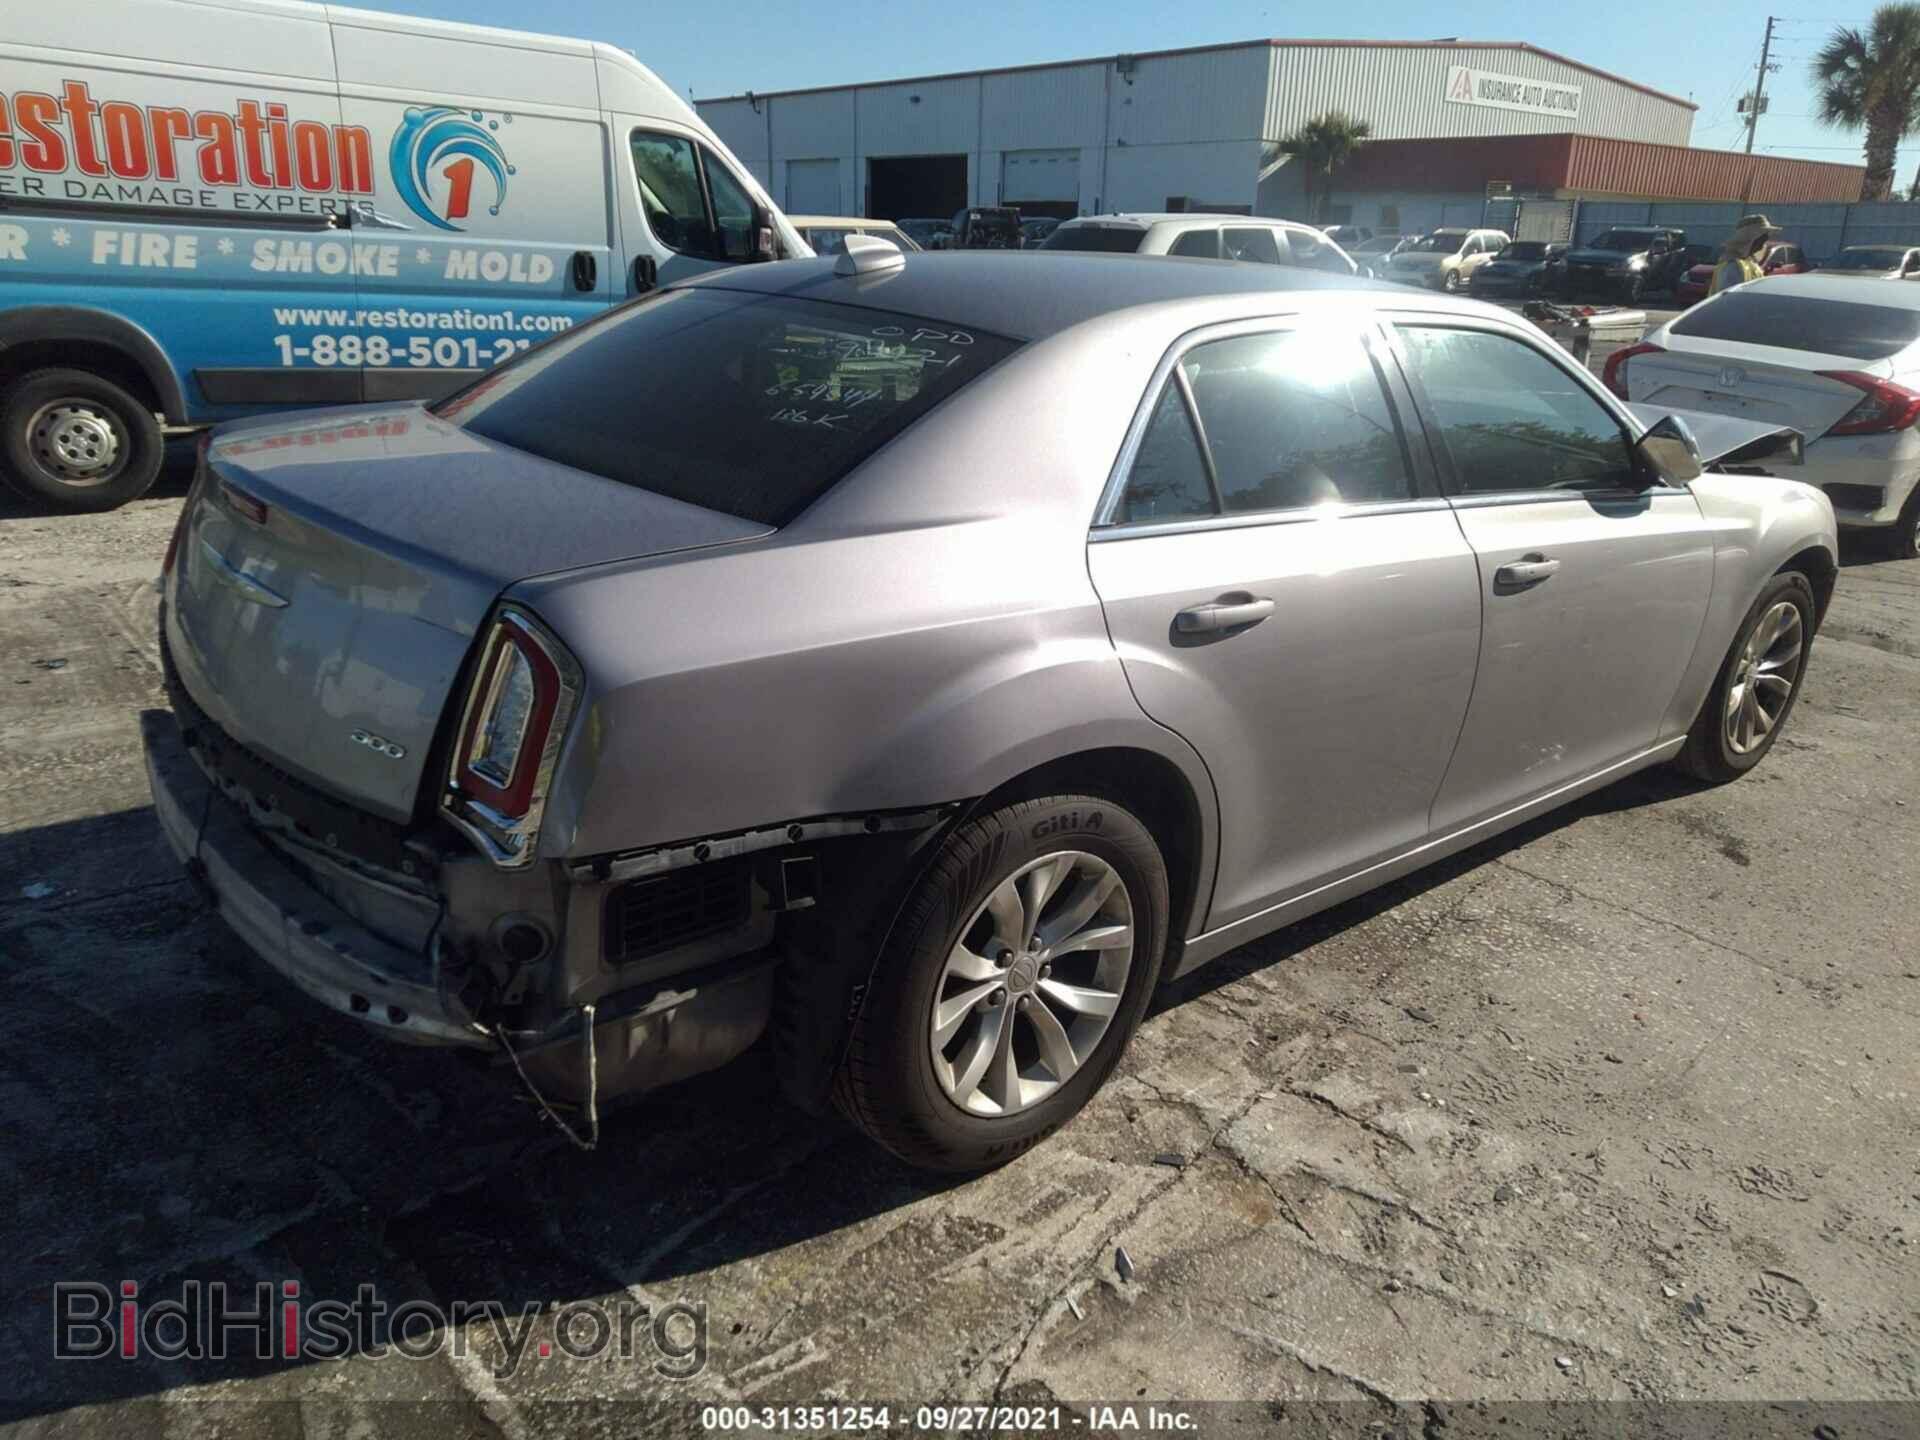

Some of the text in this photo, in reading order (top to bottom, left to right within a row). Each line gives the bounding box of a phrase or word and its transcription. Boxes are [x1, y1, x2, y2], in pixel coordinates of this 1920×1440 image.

[1478, 78, 1580, 112] INSURANCE AUTO AUCTIONS
[64, 180, 217, 208] DAMAGE
[233, 192, 376, 216] EXPERTS
[92, 230, 199, 269] FIRE
[250, 238, 400, 277] SMOKE
[443, 249, 555, 284] MOLD
[273, 308, 573, 332] www.restoration1.com
[274, 334, 530, 368] 1-888-501-2
